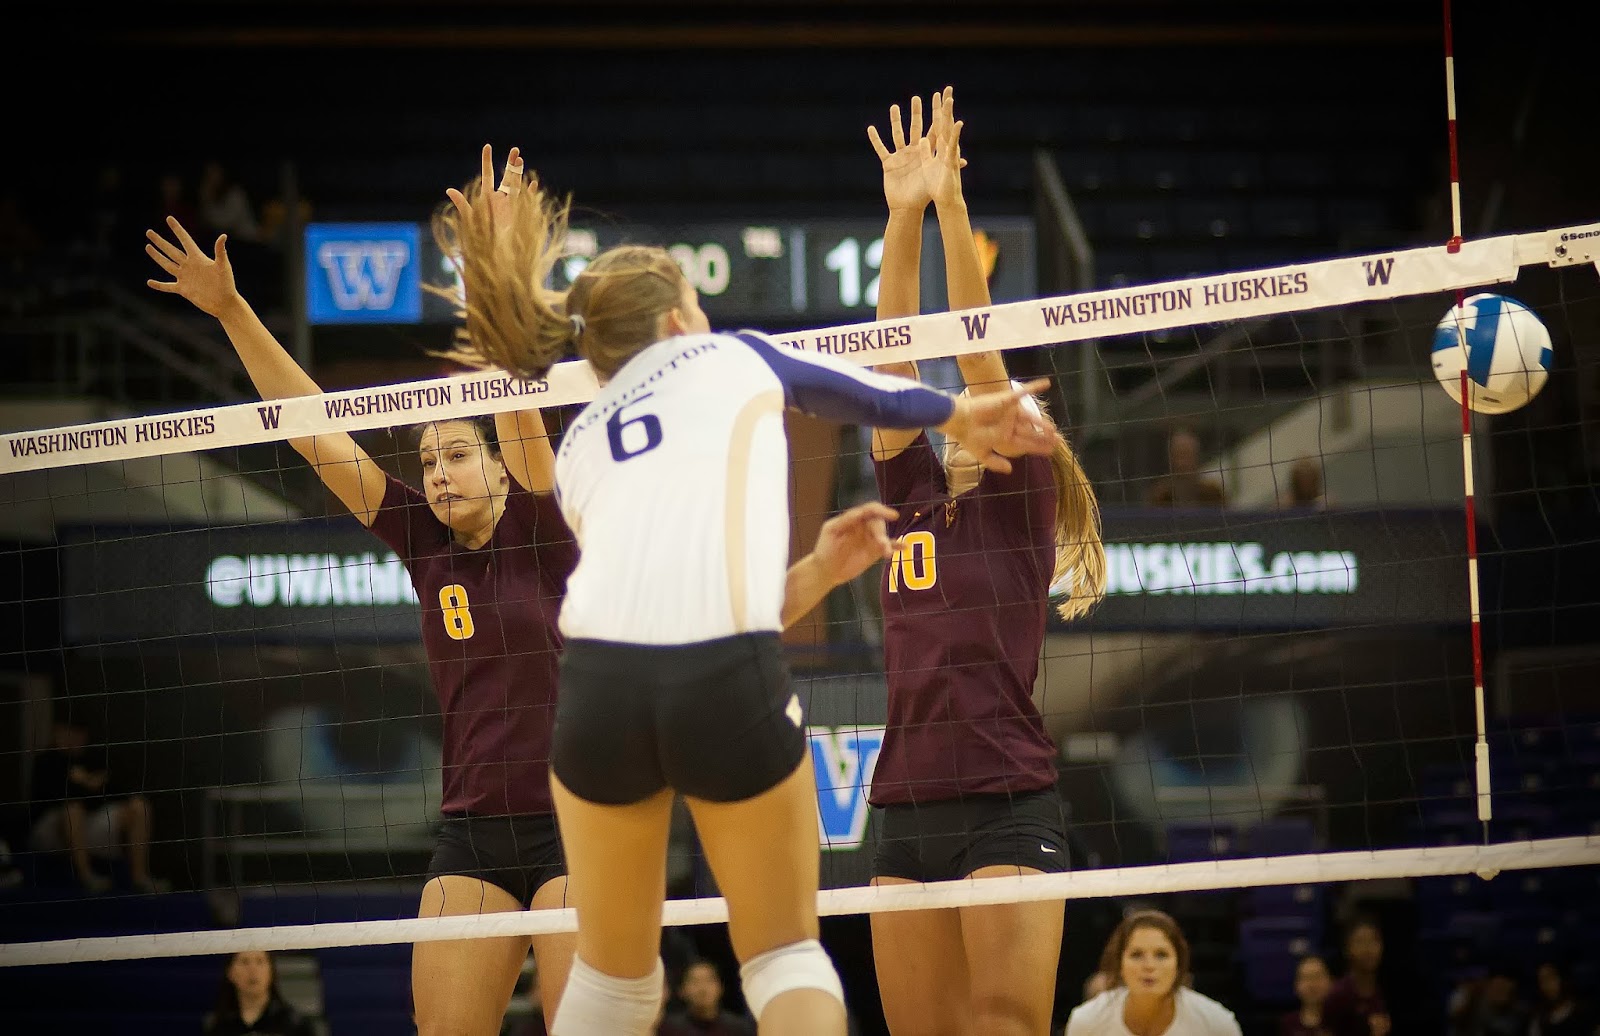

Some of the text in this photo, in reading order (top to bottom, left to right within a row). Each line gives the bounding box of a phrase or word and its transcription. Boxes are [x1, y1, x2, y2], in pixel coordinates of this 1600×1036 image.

[319, 240, 410, 311] W
[1362, 258, 1395, 286] W
[1042, 272, 1309, 327] WASHINGTON HUSKIES
[815, 324, 912, 355] HUSKIES
[961, 313, 991, 341] W
[257, 405, 282, 431] W
[324, 376, 549, 420] WASHINGTON HUSKIES
[8, 414, 216, 458] WASHINGTON HUSKIES
[606, 391, 663, 463] 6
[888, 530, 937, 593] 10
[438, 583, 475, 640] 8
